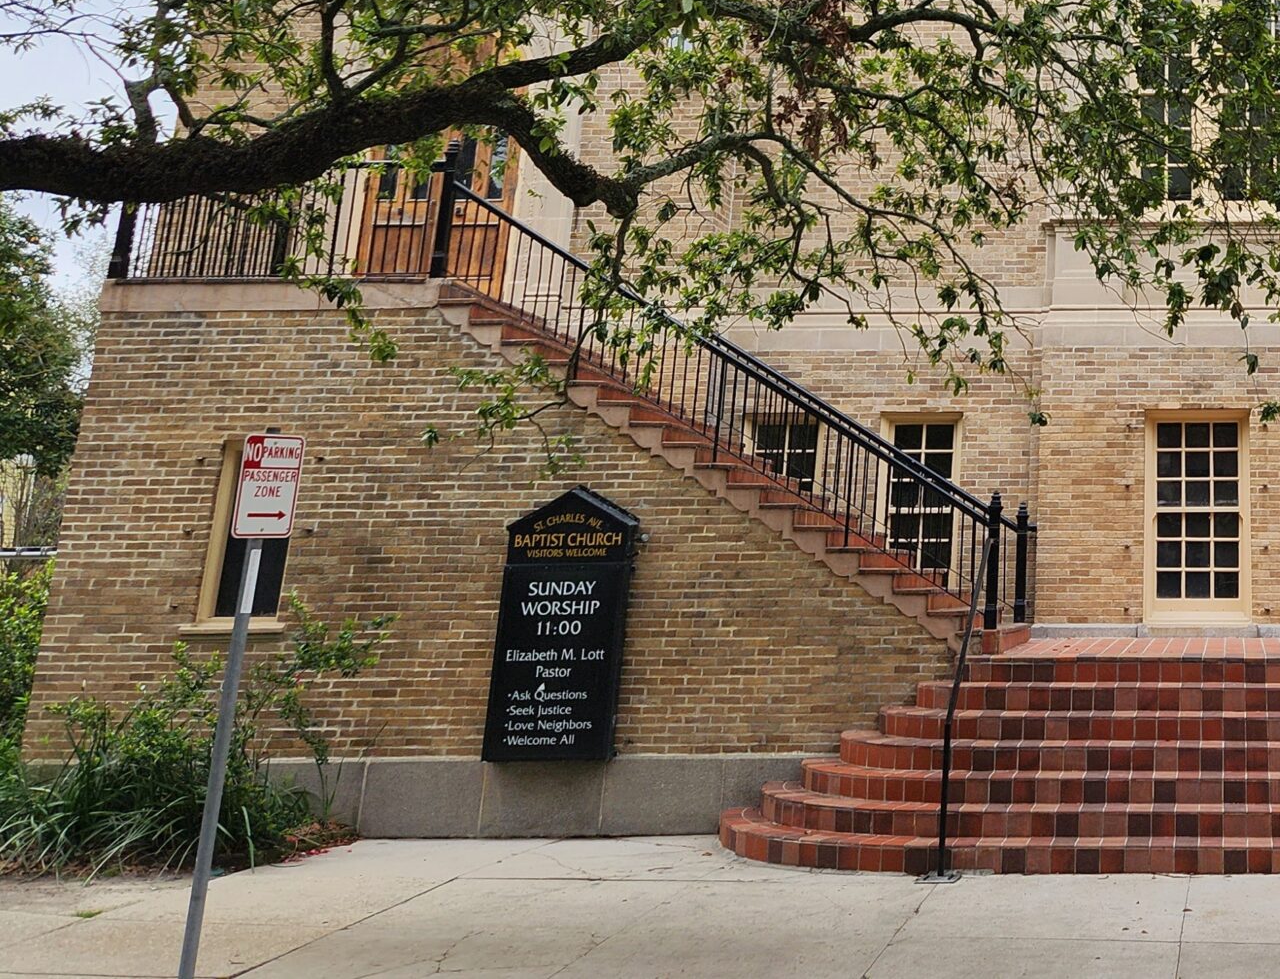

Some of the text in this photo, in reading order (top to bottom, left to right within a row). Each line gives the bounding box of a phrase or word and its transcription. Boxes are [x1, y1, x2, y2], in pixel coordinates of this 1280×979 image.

[244, 443, 300, 461] NO PARKING
[244, 471, 296, 482] PASSENGER
[254, 486, 282, 497] ZONE
[534, 521, 545, 532] ST.
[547, 513, 585, 526] CHARLES
[514, 532, 622, 548] BAPTIST CHURCH
[527, 548, 607, 558] VISITORS WELCOME
[528, 580, 596, 597] SUNDAY
[521, 600, 600, 616] WORSHIP
[537, 620, 581, 636] 11:00
[506, 649, 605, 662] Elizabeth M. Lott
[536, 666, 572, 678] Pastor
[534, 688, 587, 702] Questions
[538, 704, 572, 717] Justice
[538, 719, 592, 733] Neighbors
[560, 735, 574, 745] All
